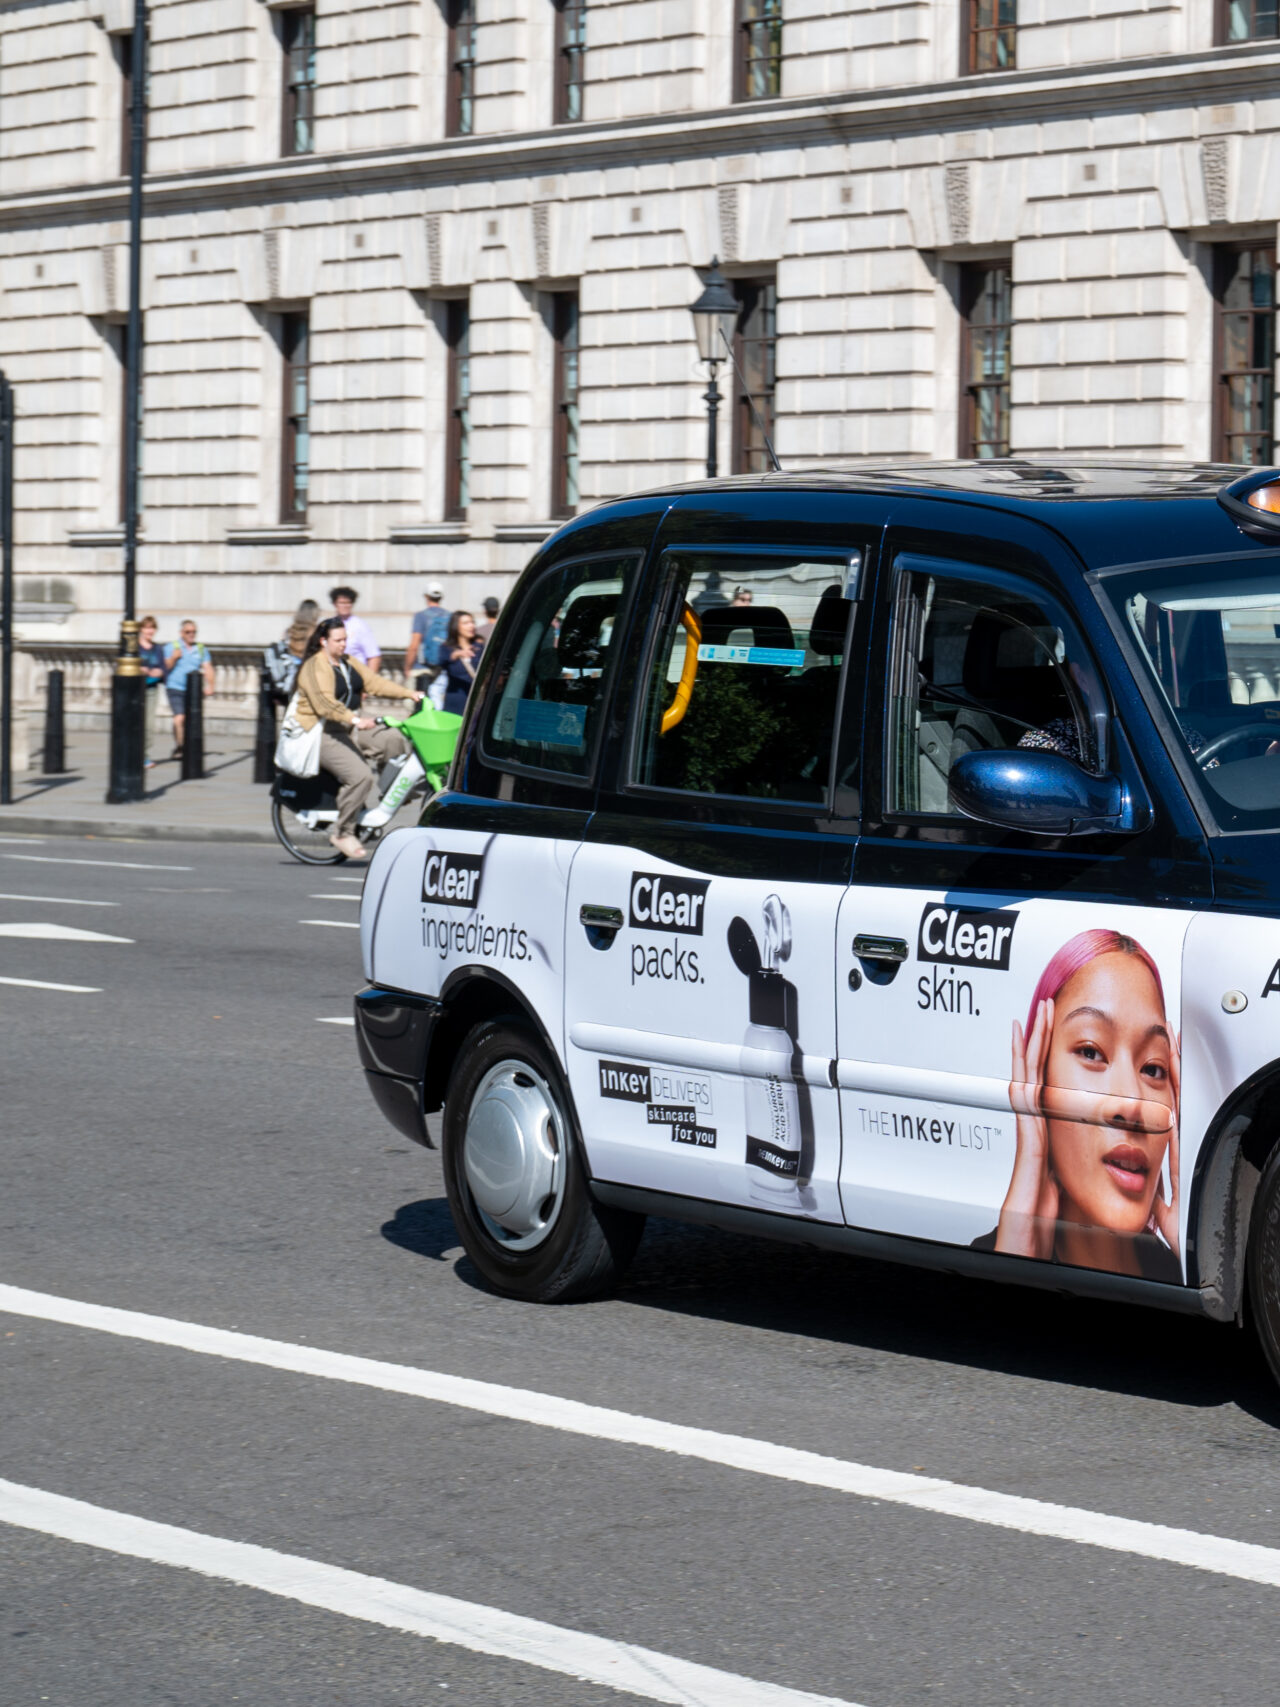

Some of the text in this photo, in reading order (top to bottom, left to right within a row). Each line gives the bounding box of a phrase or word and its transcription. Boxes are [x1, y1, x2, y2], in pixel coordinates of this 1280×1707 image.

[424, 855, 480, 901] Clear
[632, 877, 704, 927] Clear
[421, 907, 532, 962] ingredients.
[922, 908, 1012, 962] Clear
[631, 937, 705, 986] packs.
[917, 964, 980, 1017] skin.
[648, 1107, 696, 1122] skincare
[653, 1076, 710, 1105] DELIVERS
[674, 1124, 715, 1145] for you
